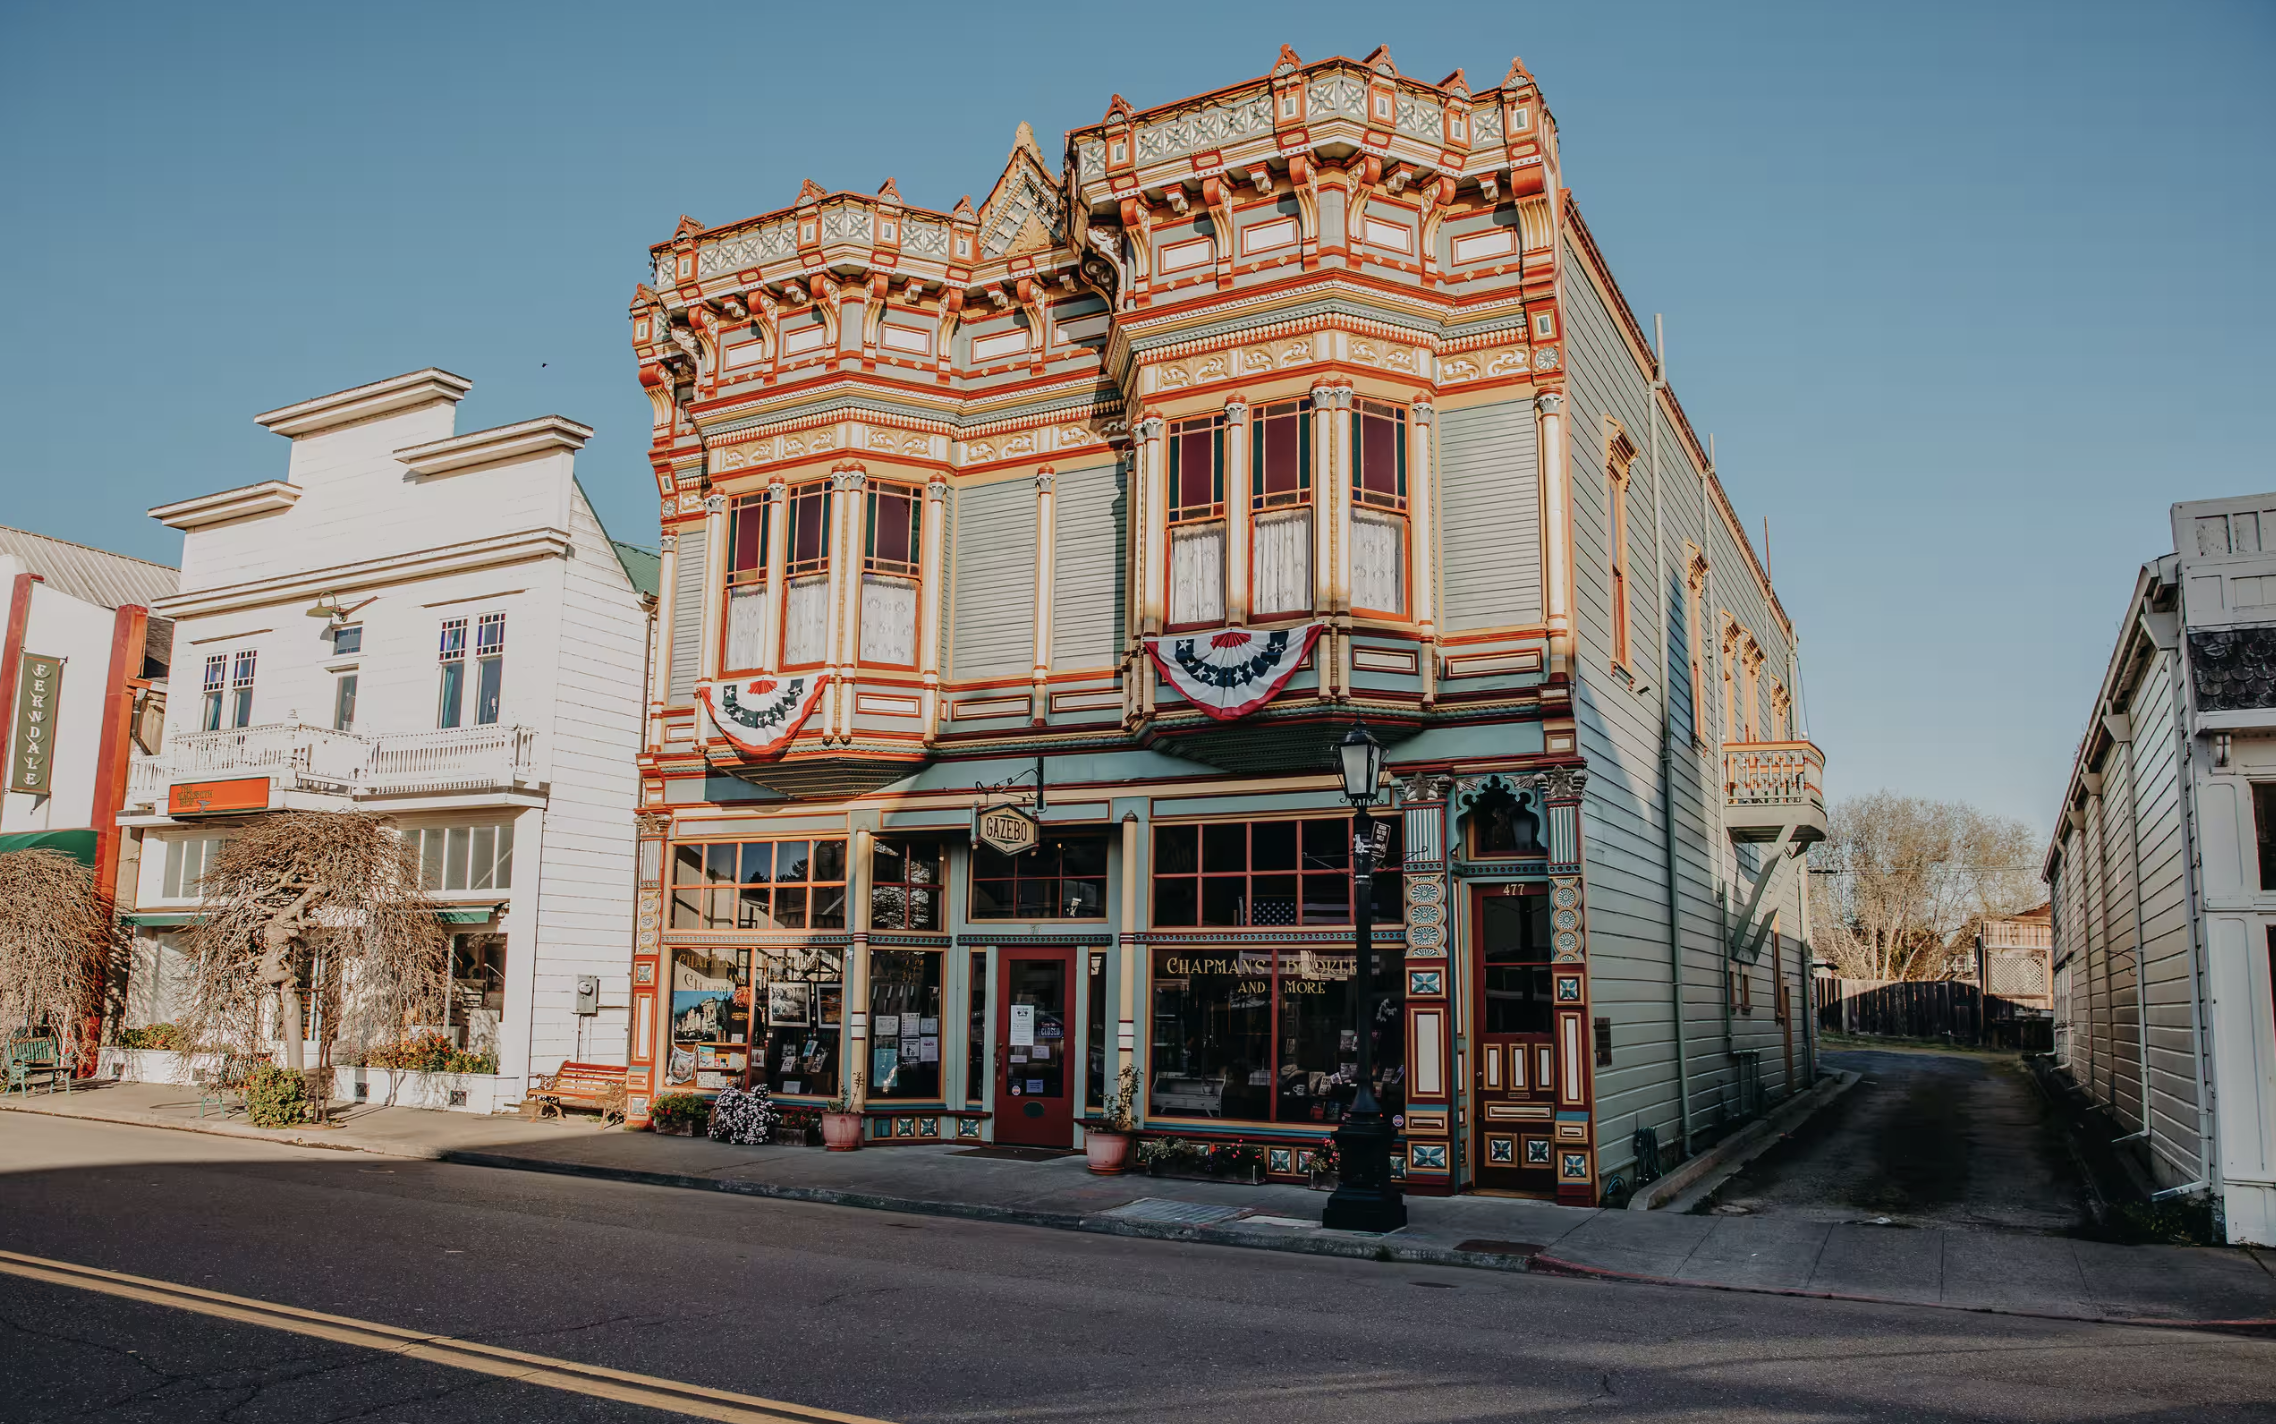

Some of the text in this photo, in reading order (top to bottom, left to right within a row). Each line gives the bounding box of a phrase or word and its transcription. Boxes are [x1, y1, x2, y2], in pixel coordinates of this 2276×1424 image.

[26, 663, 48, 785] FERNDALE
[986, 816, 1028, 842] GAZEBO
[1502, 883, 1525, 896] 477
[1166, 957, 1358, 976] CHAPMAN'S BOOKER
[728, 974, 747, 985] AND
[1238, 980, 1326, 994] AND MORE
[1040, 1027, 1061, 1036] CLOSED
